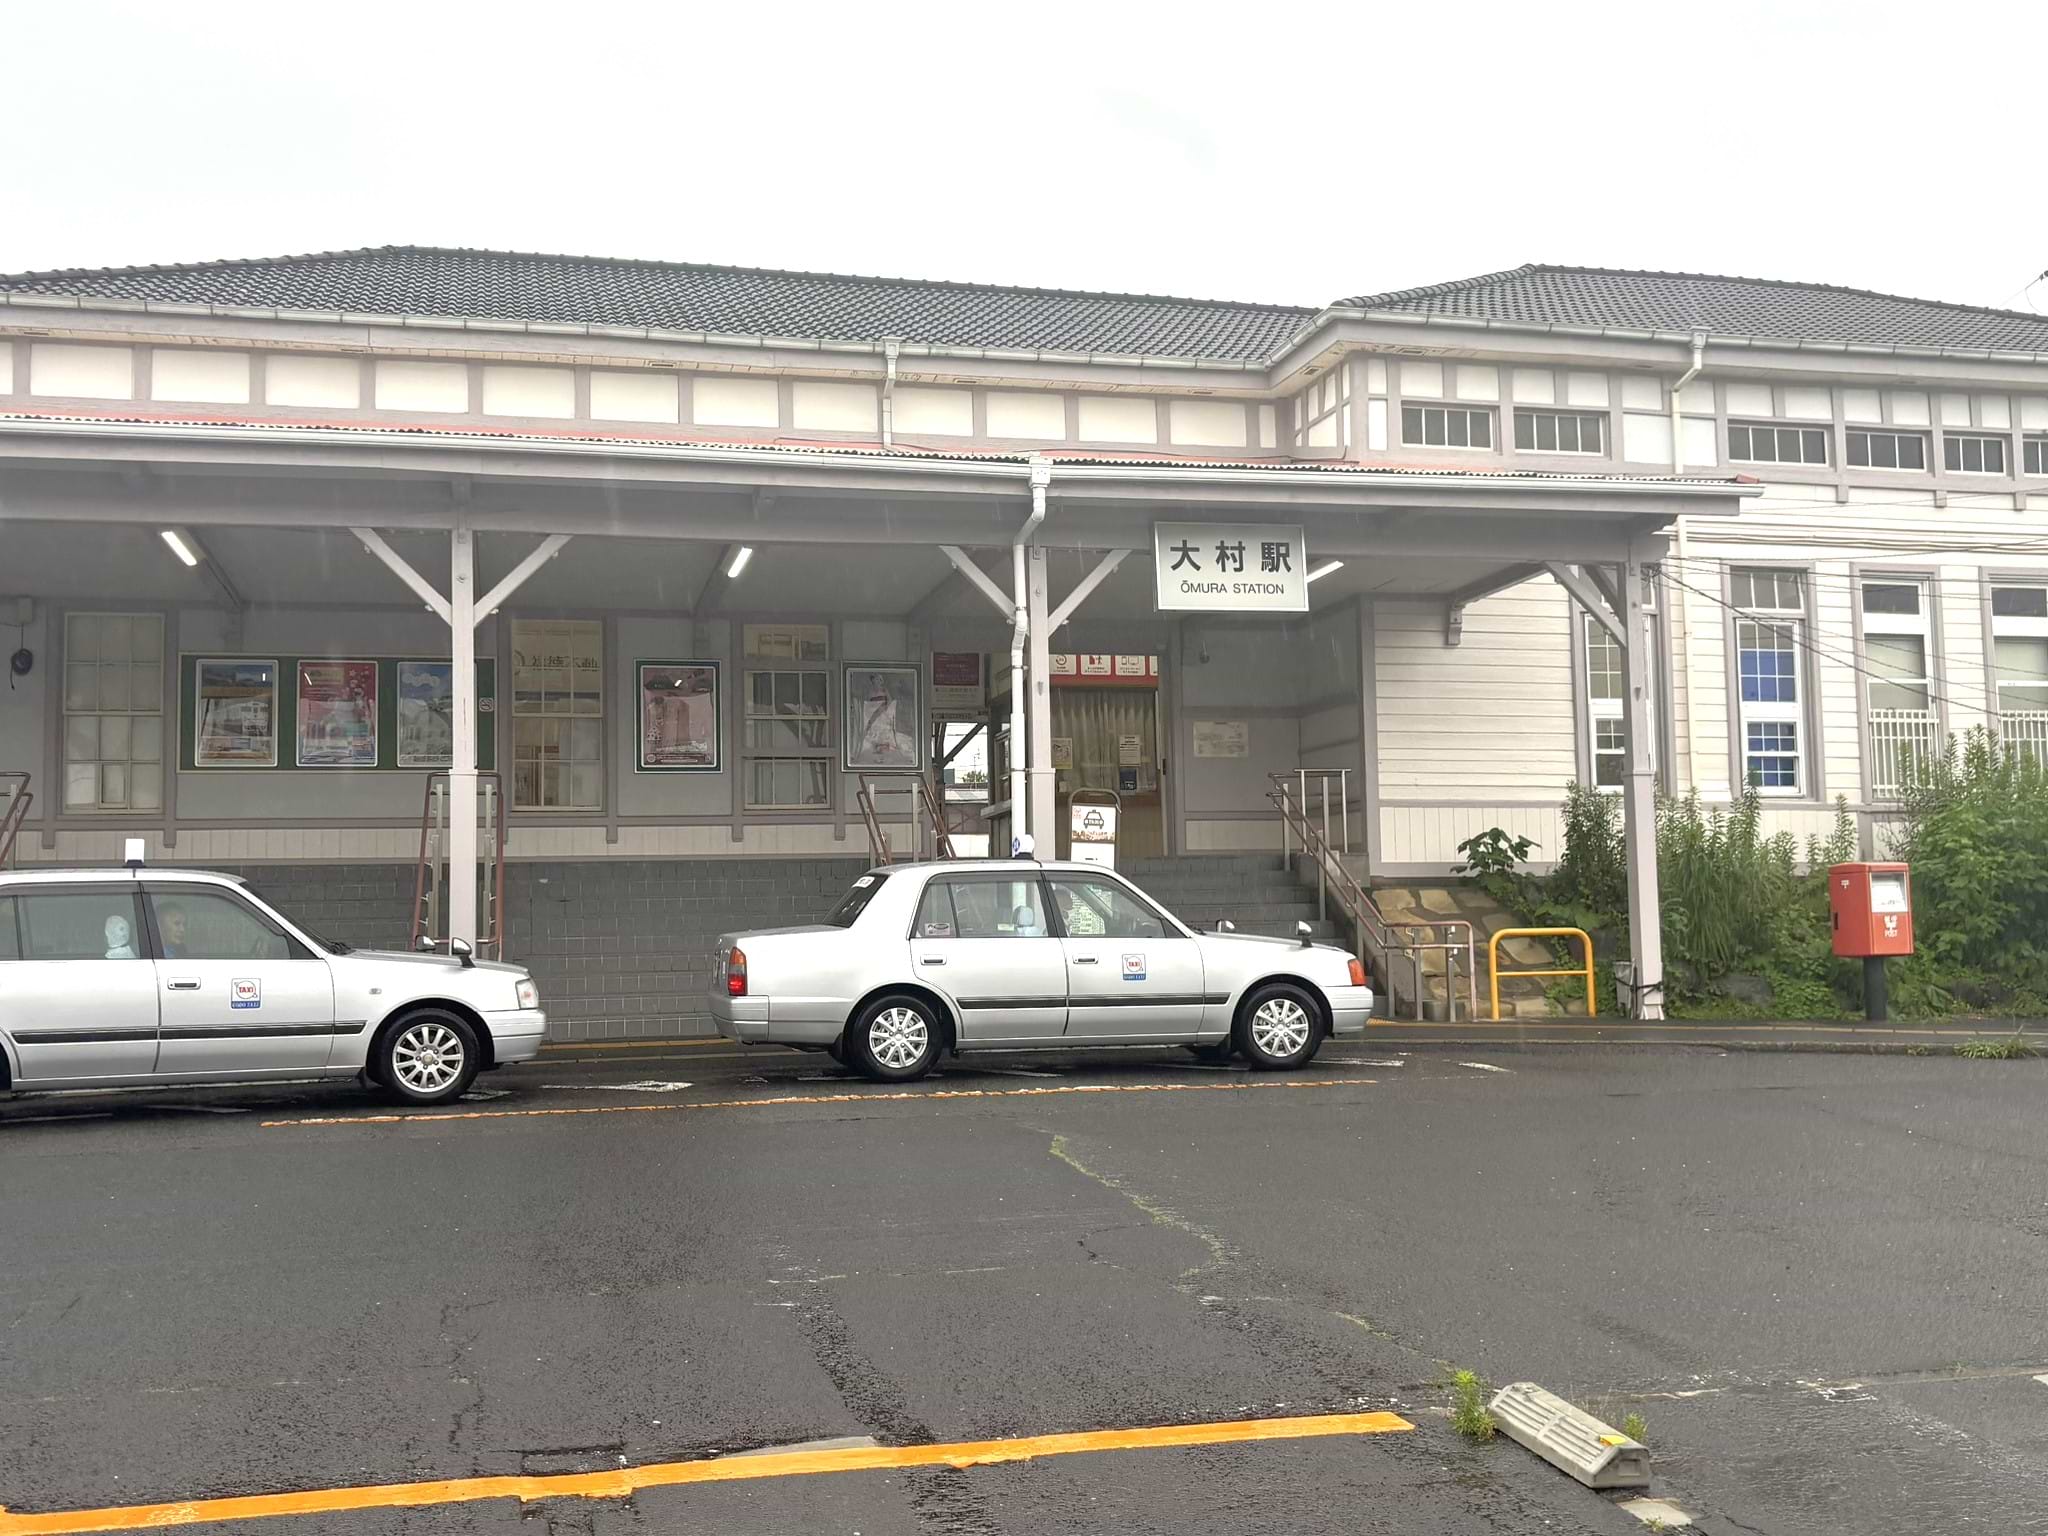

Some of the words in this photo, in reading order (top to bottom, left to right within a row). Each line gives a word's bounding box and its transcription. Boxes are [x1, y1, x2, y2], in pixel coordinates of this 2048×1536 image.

[1170, 539, 1292, 573] 大村駅
[1180, 580, 1228, 594] ŌMURA
[1233, 583, 1285, 595] STATION
